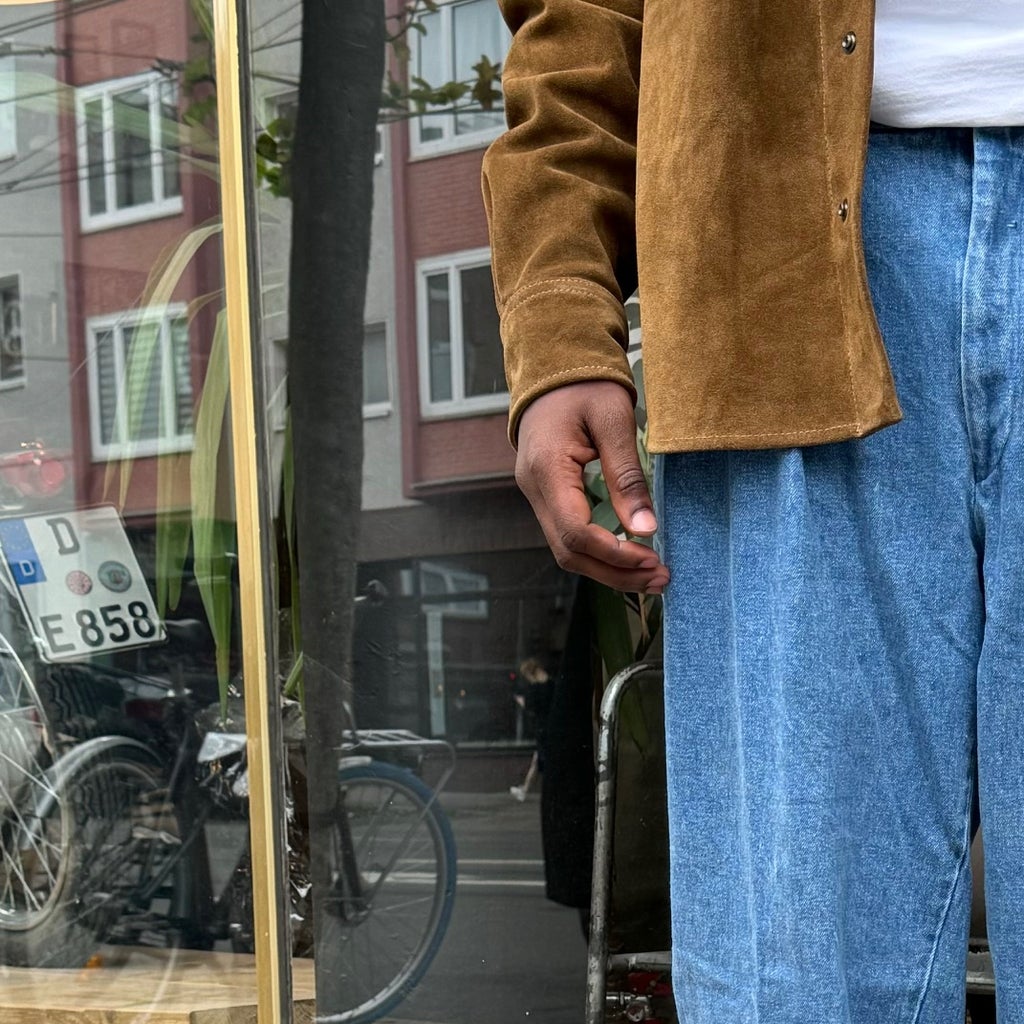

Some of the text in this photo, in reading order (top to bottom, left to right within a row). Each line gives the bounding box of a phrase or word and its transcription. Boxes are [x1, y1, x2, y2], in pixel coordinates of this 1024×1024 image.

[46, 517, 80, 556] D
[19, 559, 35, 577] D
[39, 600, 156, 654] E 858
